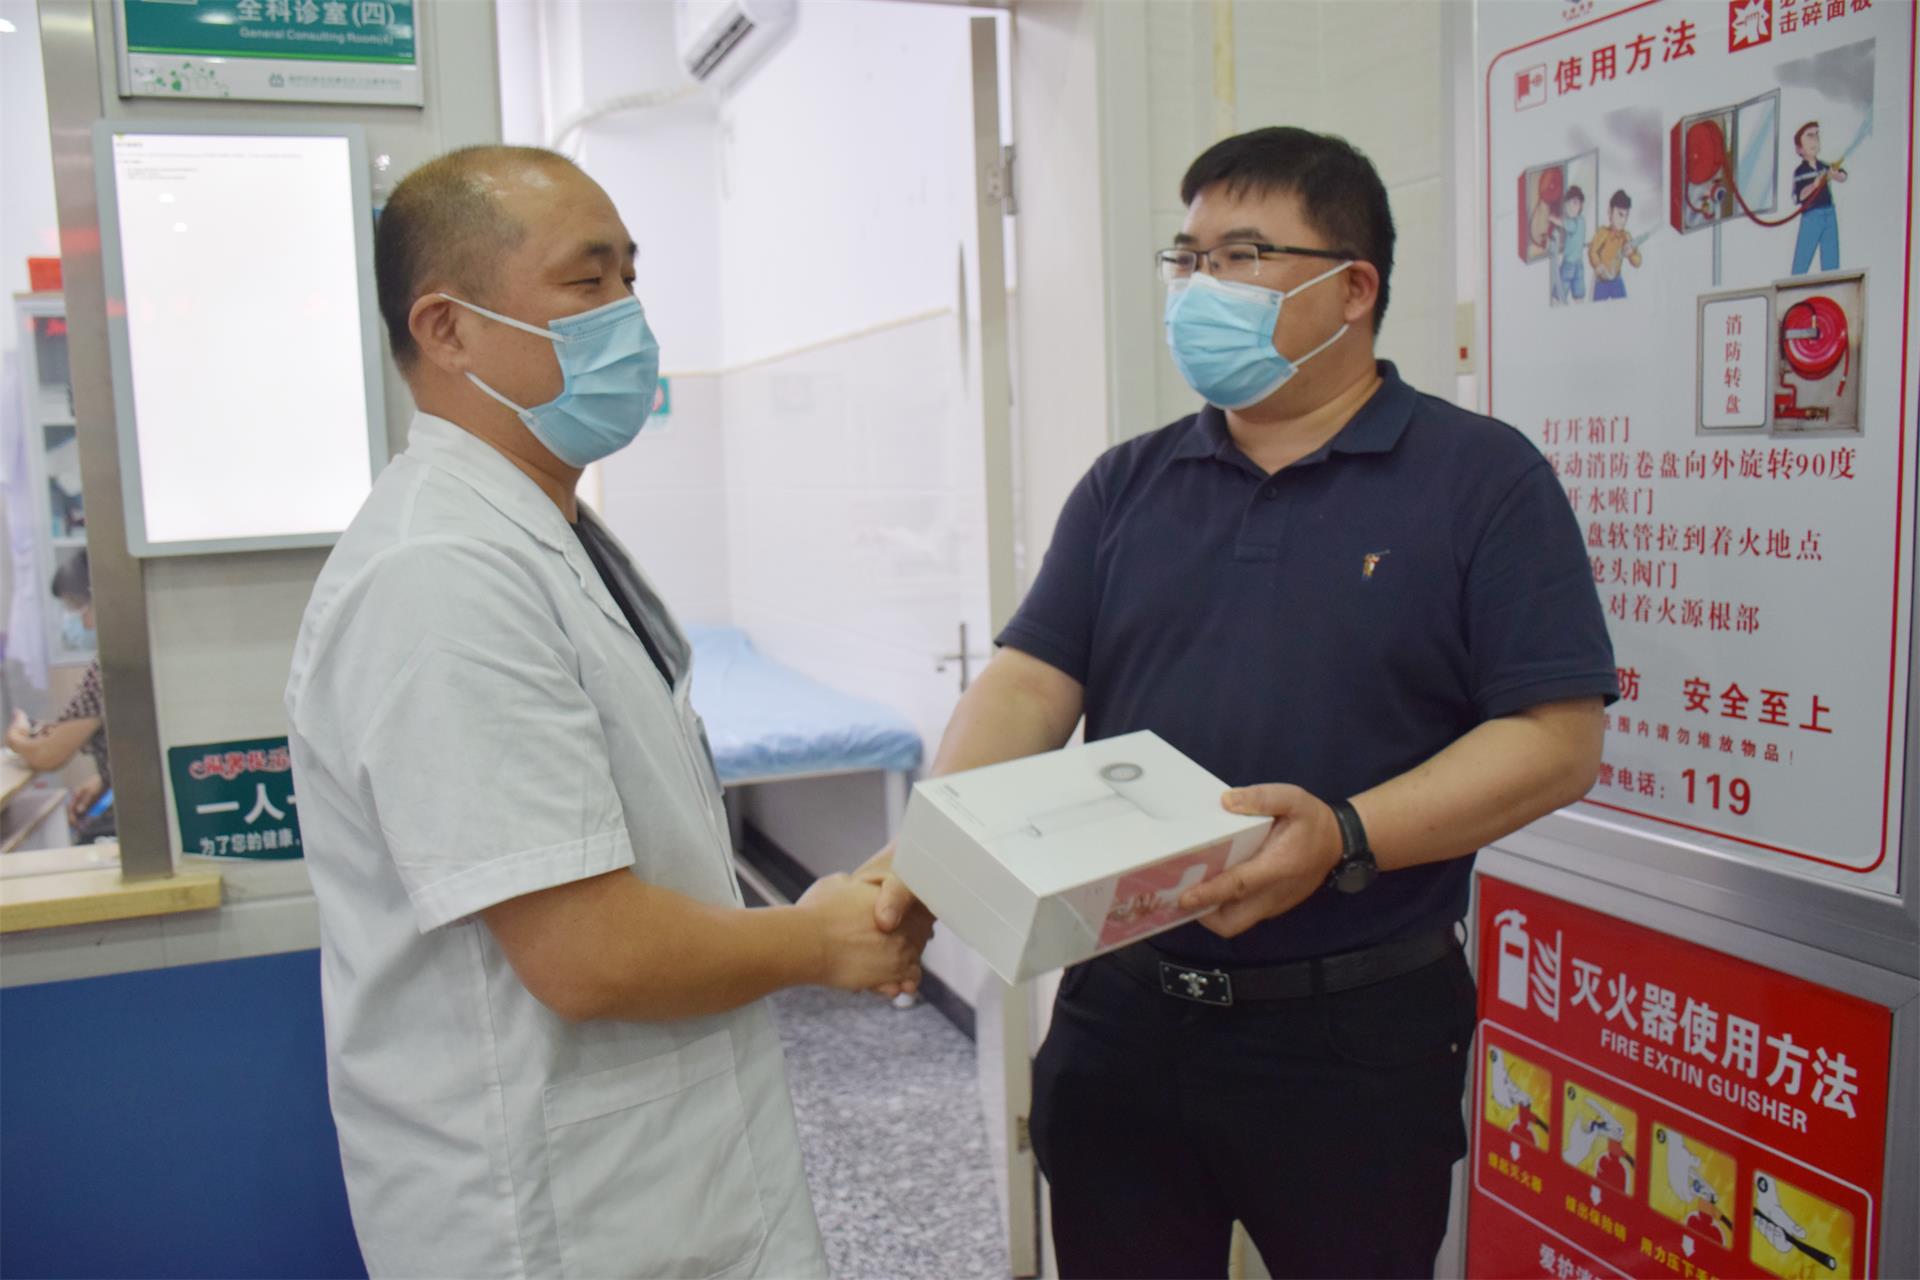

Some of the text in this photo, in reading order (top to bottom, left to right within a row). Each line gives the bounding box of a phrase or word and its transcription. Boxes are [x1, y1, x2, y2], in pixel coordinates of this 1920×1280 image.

[239, 25, 284, 39] General
[287, 29, 345, 44] Consulting
[1553, 19, 1697, 97] 使用方法
[1724, 313, 1741, 415] 消防转盘
[1542, 416, 1630, 445] 打开箱门
[1616, 667, 1834, 734] 防 安全至上
[196, 782, 297, 824] 一人
[1681, 767, 1752, 816] 119
[1570, 957, 1859, 1119] 灭火器使用方法
[1600, 1028, 1809, 1134] FIRE EXTIN GUISHER
